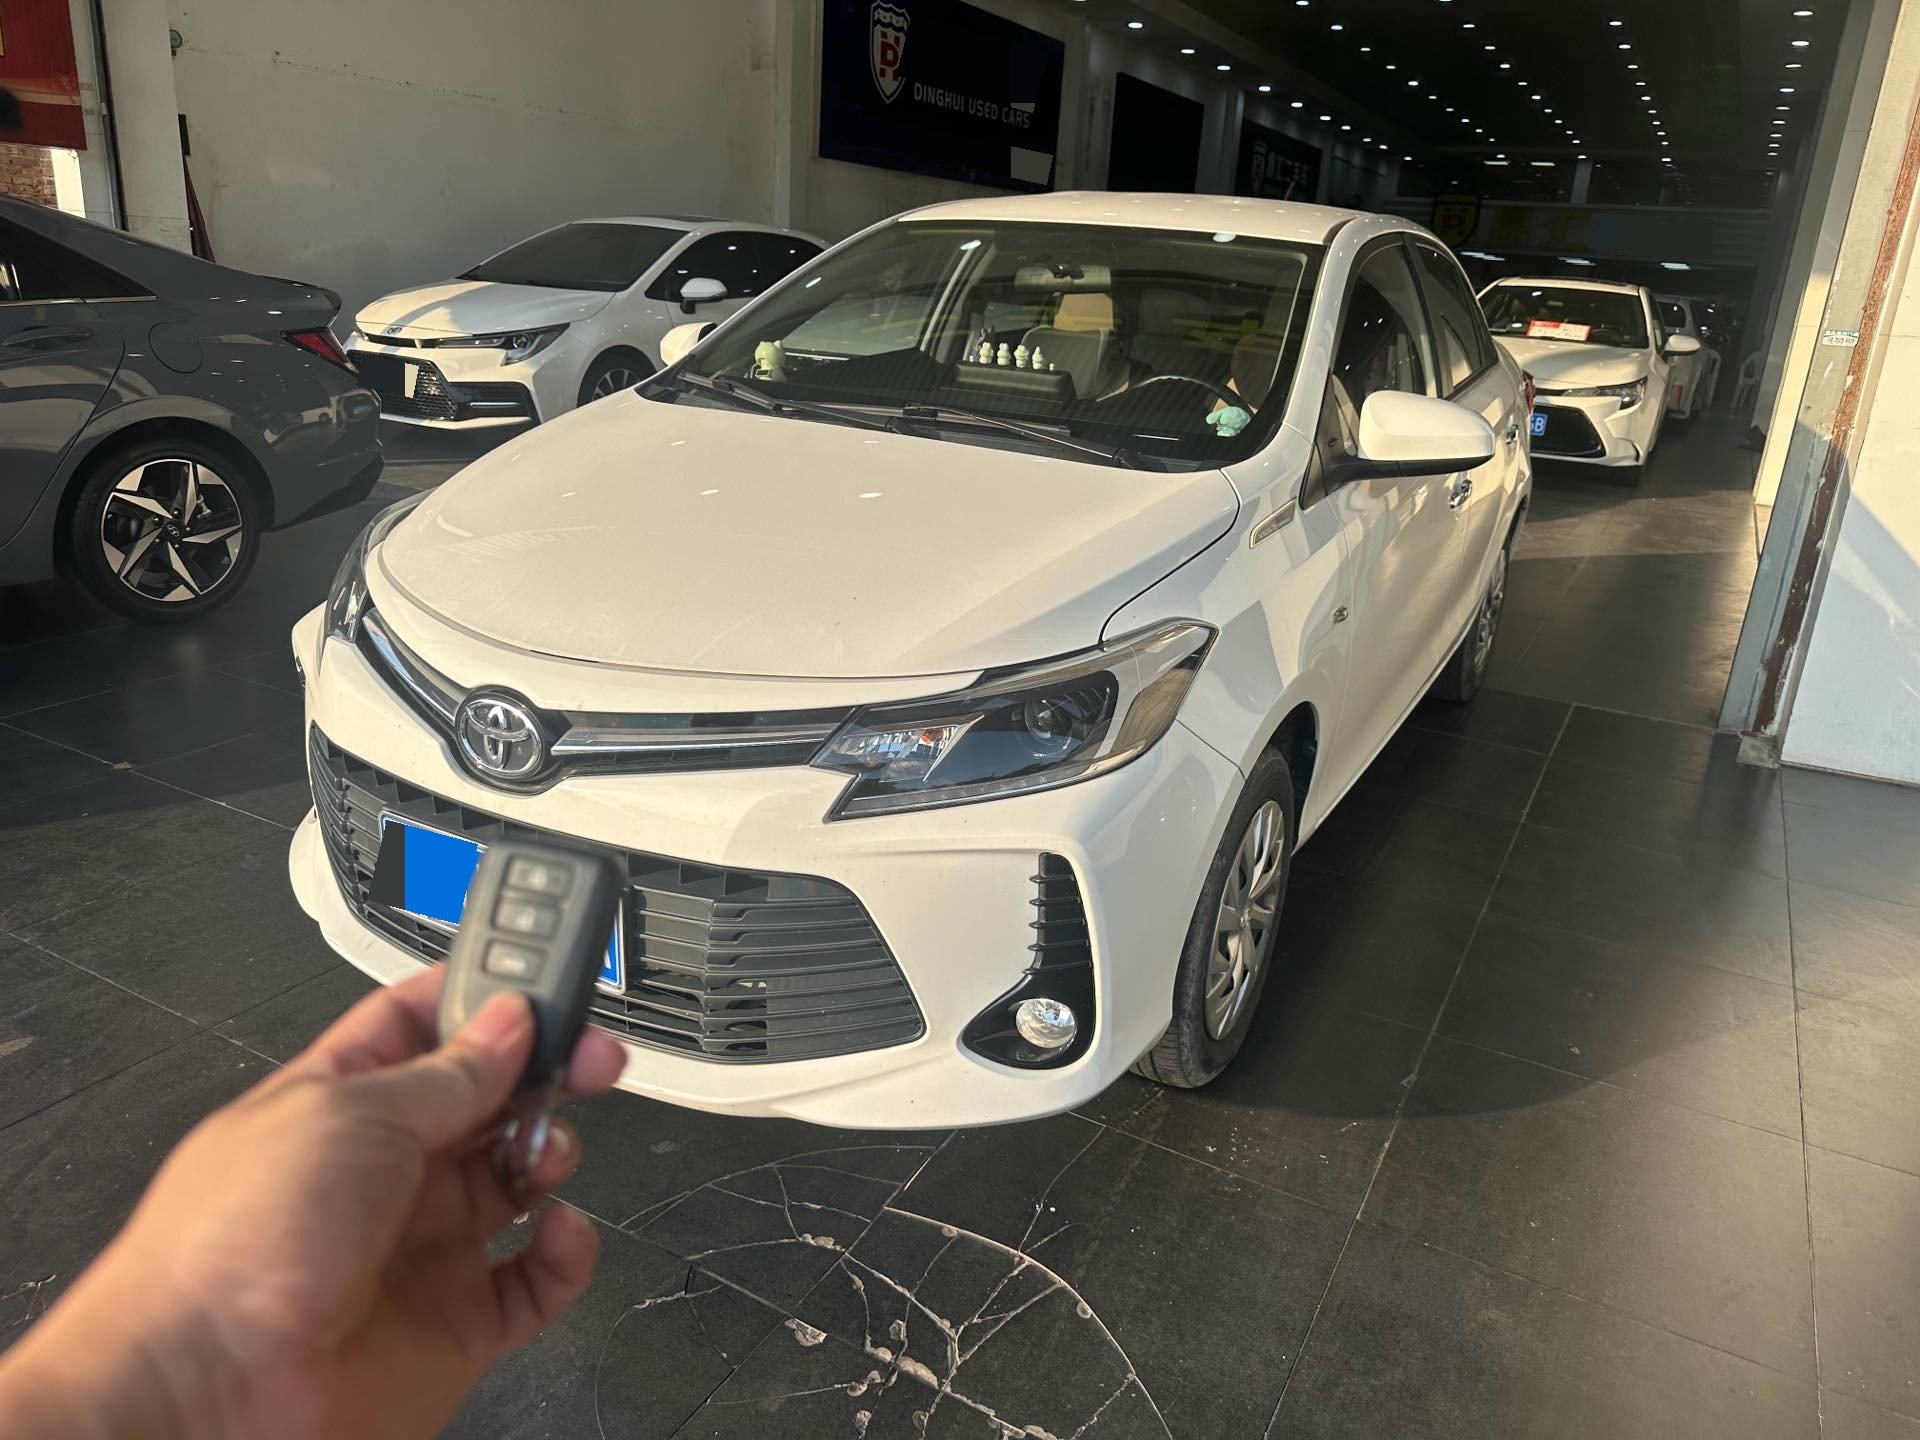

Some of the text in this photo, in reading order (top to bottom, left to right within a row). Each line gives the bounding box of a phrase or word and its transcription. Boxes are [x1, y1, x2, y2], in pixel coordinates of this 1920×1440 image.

[914, 82, 1030, 129] DINGHUI USED CARS
